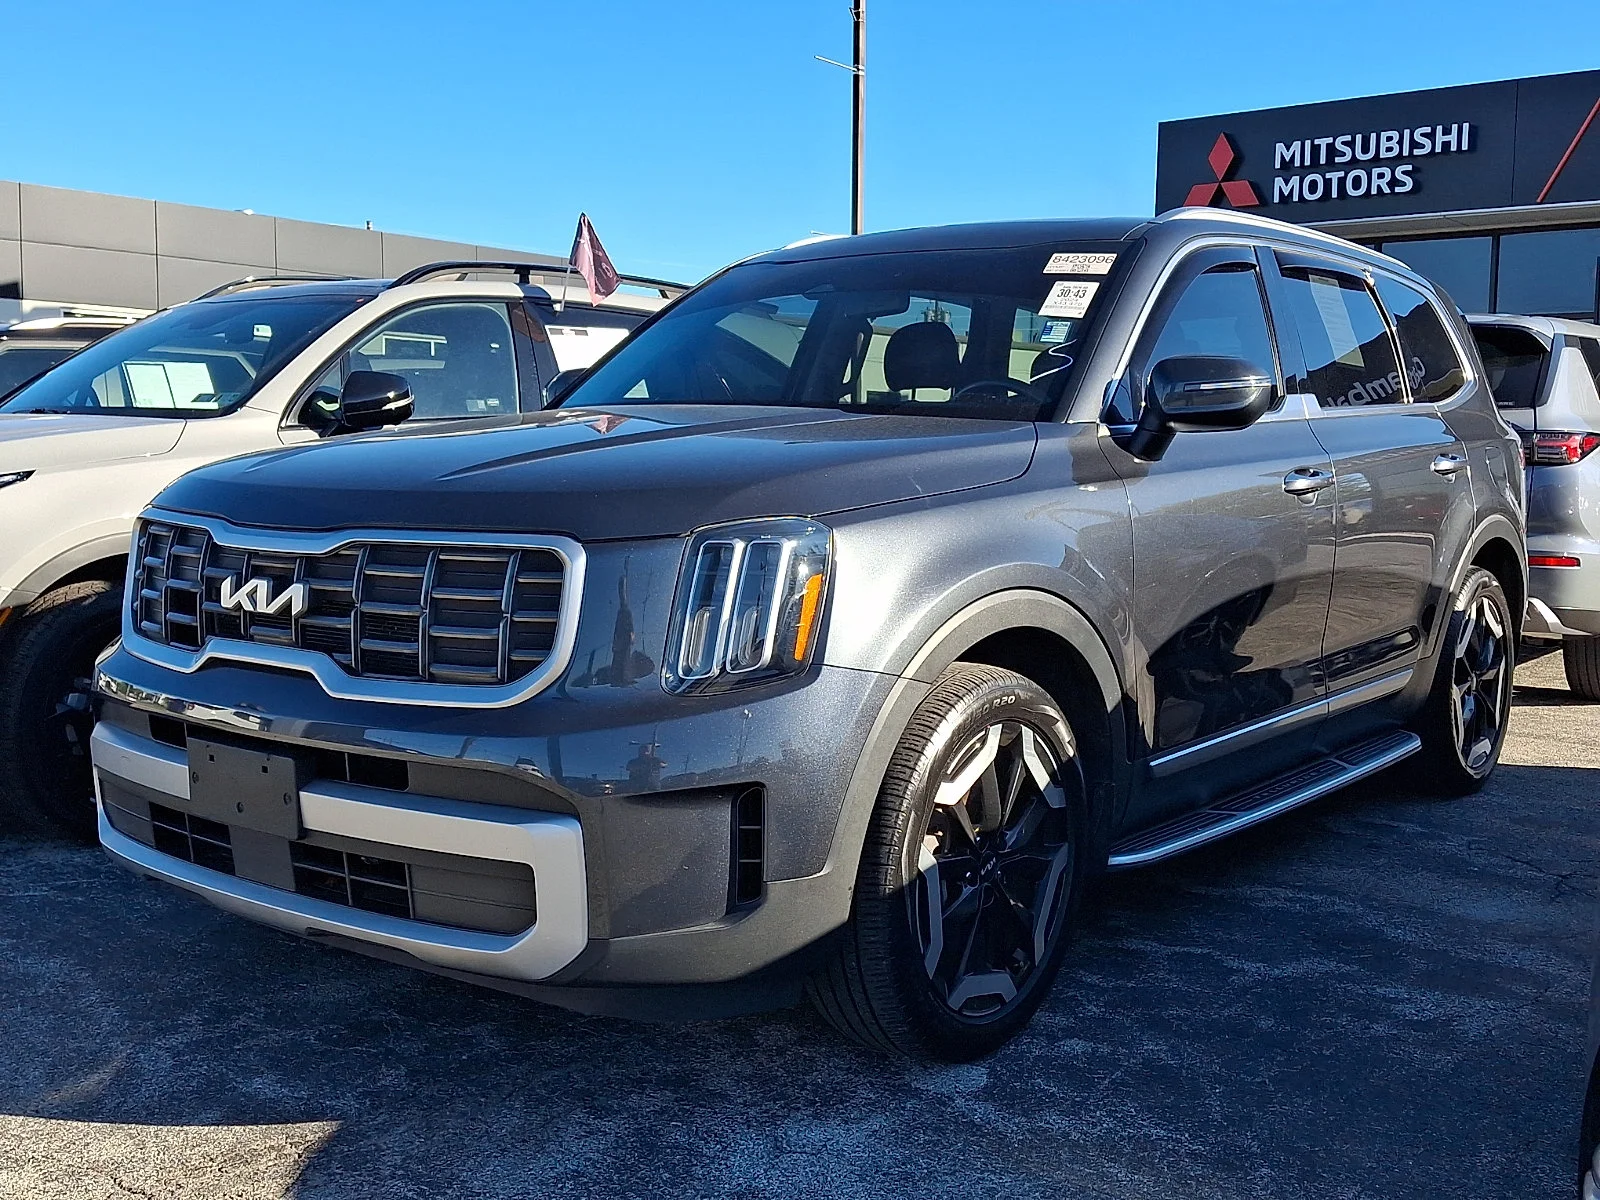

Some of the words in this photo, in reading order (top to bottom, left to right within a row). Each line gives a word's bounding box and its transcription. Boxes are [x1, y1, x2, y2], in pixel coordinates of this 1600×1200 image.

[1274, 122, 1471, 170] MITSUBISHI
[1273, 164, 1415, 204] MOTORS
[1057, 289, 1087, 298] 30:43
[220, 575, 306, 617] KIA
[992, 695, 1016, 710] R20
